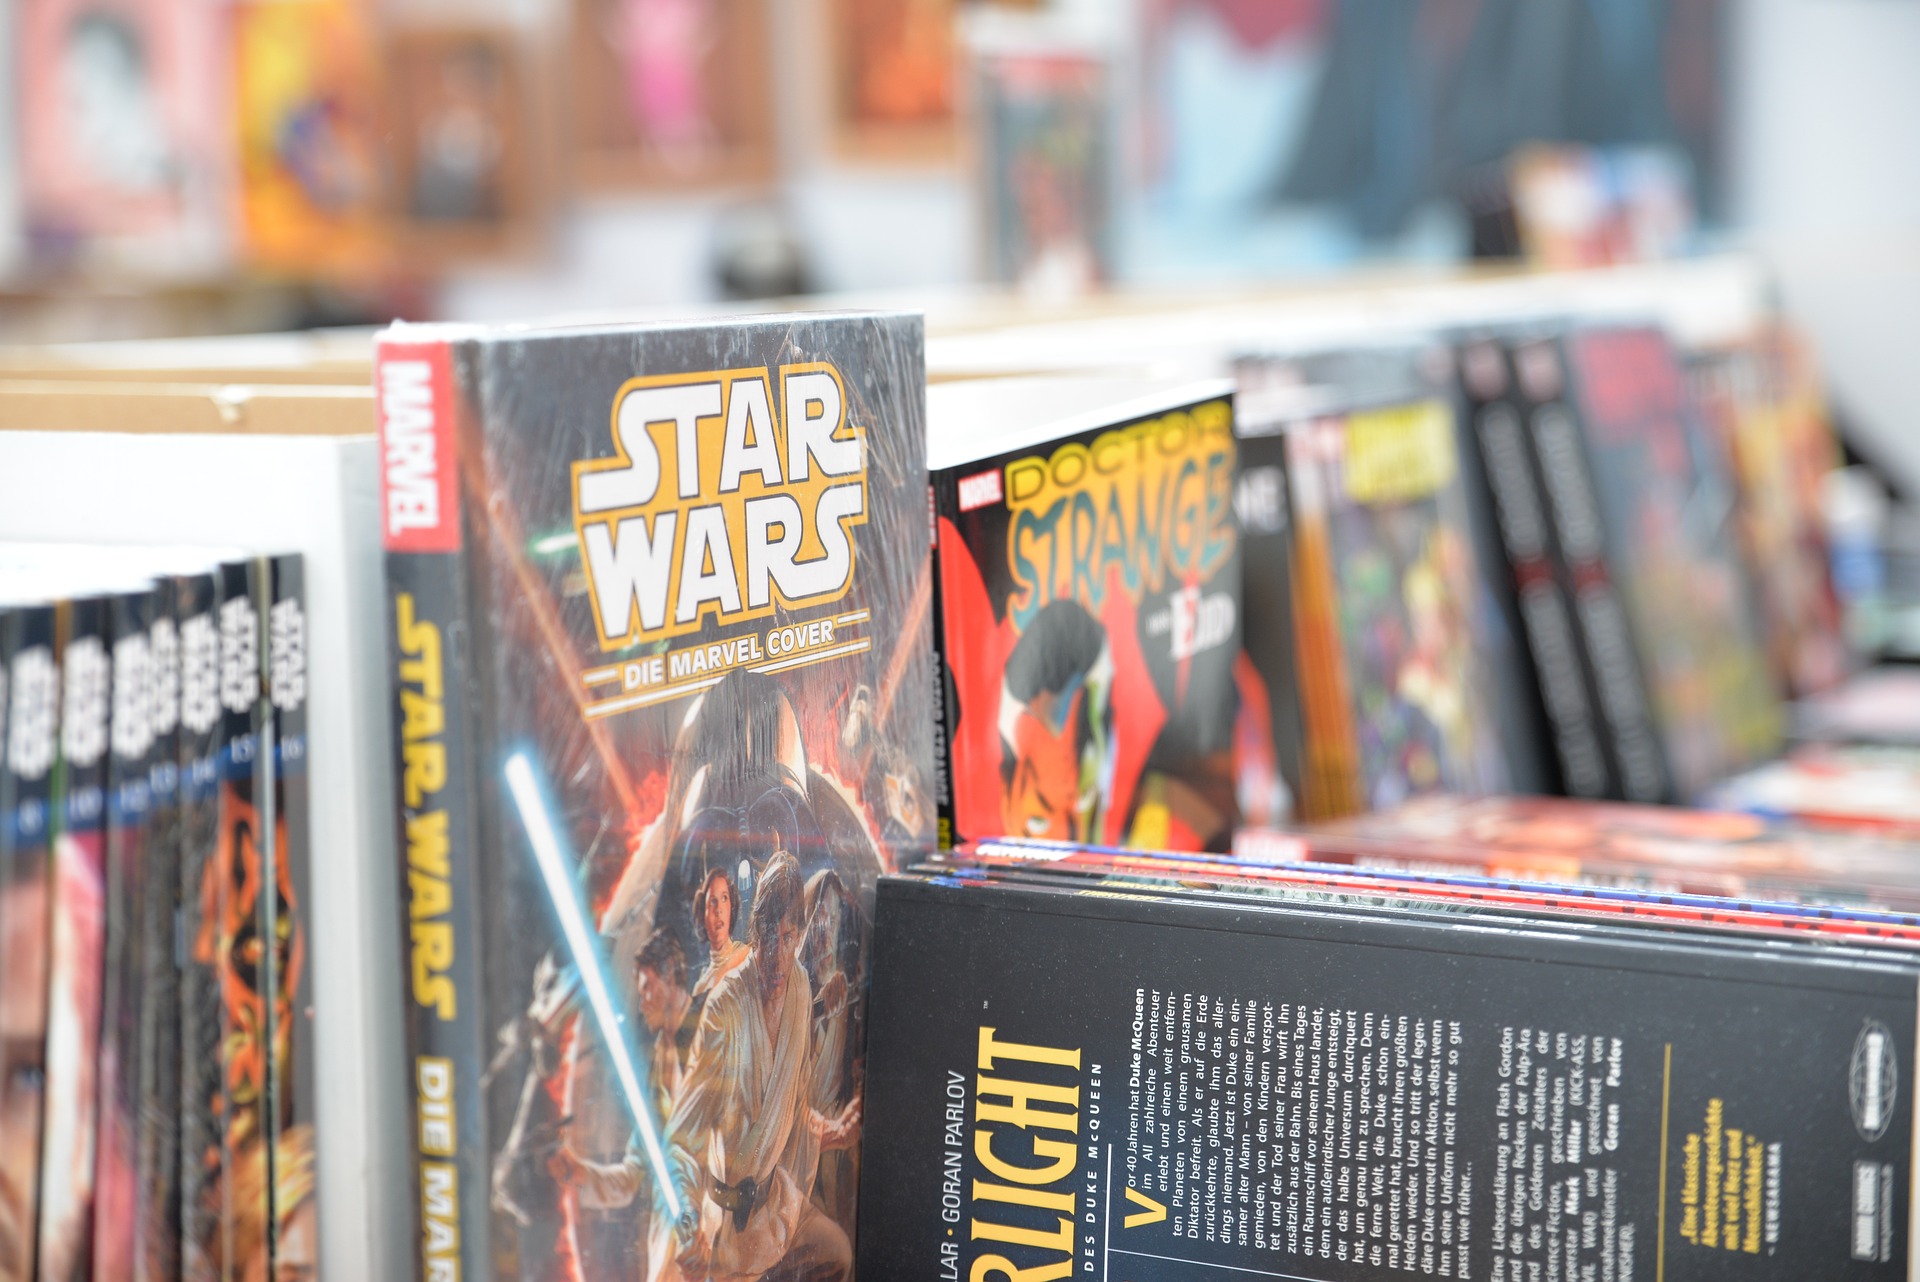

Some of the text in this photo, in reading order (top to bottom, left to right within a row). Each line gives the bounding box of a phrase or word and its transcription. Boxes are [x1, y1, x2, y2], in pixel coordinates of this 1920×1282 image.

[381, 360, 440, 534] MARVEL
[579, 373, 862, 514] STAR
[1006, 401, 1232, 506] DOCTOR
[1008, 449, 1236, 635] STRANGE
[582, 481, 863, 640] WARS
[624, 620, 834, 690] DIE MARVEL COVER
[393, 592, 459, 1282] STAR WARS DIE MAR
[1130, 987, 1145, 1051] McQueen
[969, 1025, 1082, 1282] RLIGHT
[1084, 1063, 1102, 1272] DES DUKE McQUEEN
[1126, 1112, 1139, 1155] Jahren
[1126, 1155, 1138, 1173] 40
[1127, 1089, 1140, 1111] hat
[1129, 1052, 1142, 1088] Duke
[1141, 988, 1161, 1190] im All zahlreiche Abenteuer
[1156, 991, 1176, 1192] erlebt und einen weit entfern-
[1172, 993, 1193, 1237] ten Planeten von einem grausamen
[1187, 994, 1209, 1239] Diktator befreit. Als er auf die Erde
[1204, 996, 1224, 1243] zurückkehrte, glaubte ihm das aller-
[1219, 997, 1241, 1244] dings niemand. Jetzt ist Duke ein ein-
[1236, 999, 1257, 1247] samer alter Mann von seiner Familie
[1269, 1003, 1290, 1251] tet und der Tod seiner Frau wirft ihn
[1285, 1004, 1309, 1254] zusätzlich aus der Bahn. Bis eines Tages
[1302, 1006, 1325, 1257] ein Raumschiff vor seinem Haus landet,
[1334, 1009, 1359, 1262] der das halbe Universum durchquert
[1351, 1011, 1374, 1264] hat, um genau ihn zu sprechen. Denn
[1386, 1015, 1409, 1269] mal gerettet hat, braucht ihren größten
[1437, 1020, 1463, 1277] ihm seine Uniform nicht mehr so gut
[1681, 1133, 1701, 1204] klassische
[939, 1069, 966, 1282] LAR GORAN PARLOV
[1457, 1217, 1471, 1242] wie
[1457, 1244, 1471, 1280] passt
[1701, 1097, 1724, 1248] Abenteuergeschichte
[1722, 1129, 1743, 1250] mit viel Herz und
[1766, 1143, 1780, 1243] NEWSARAMA
